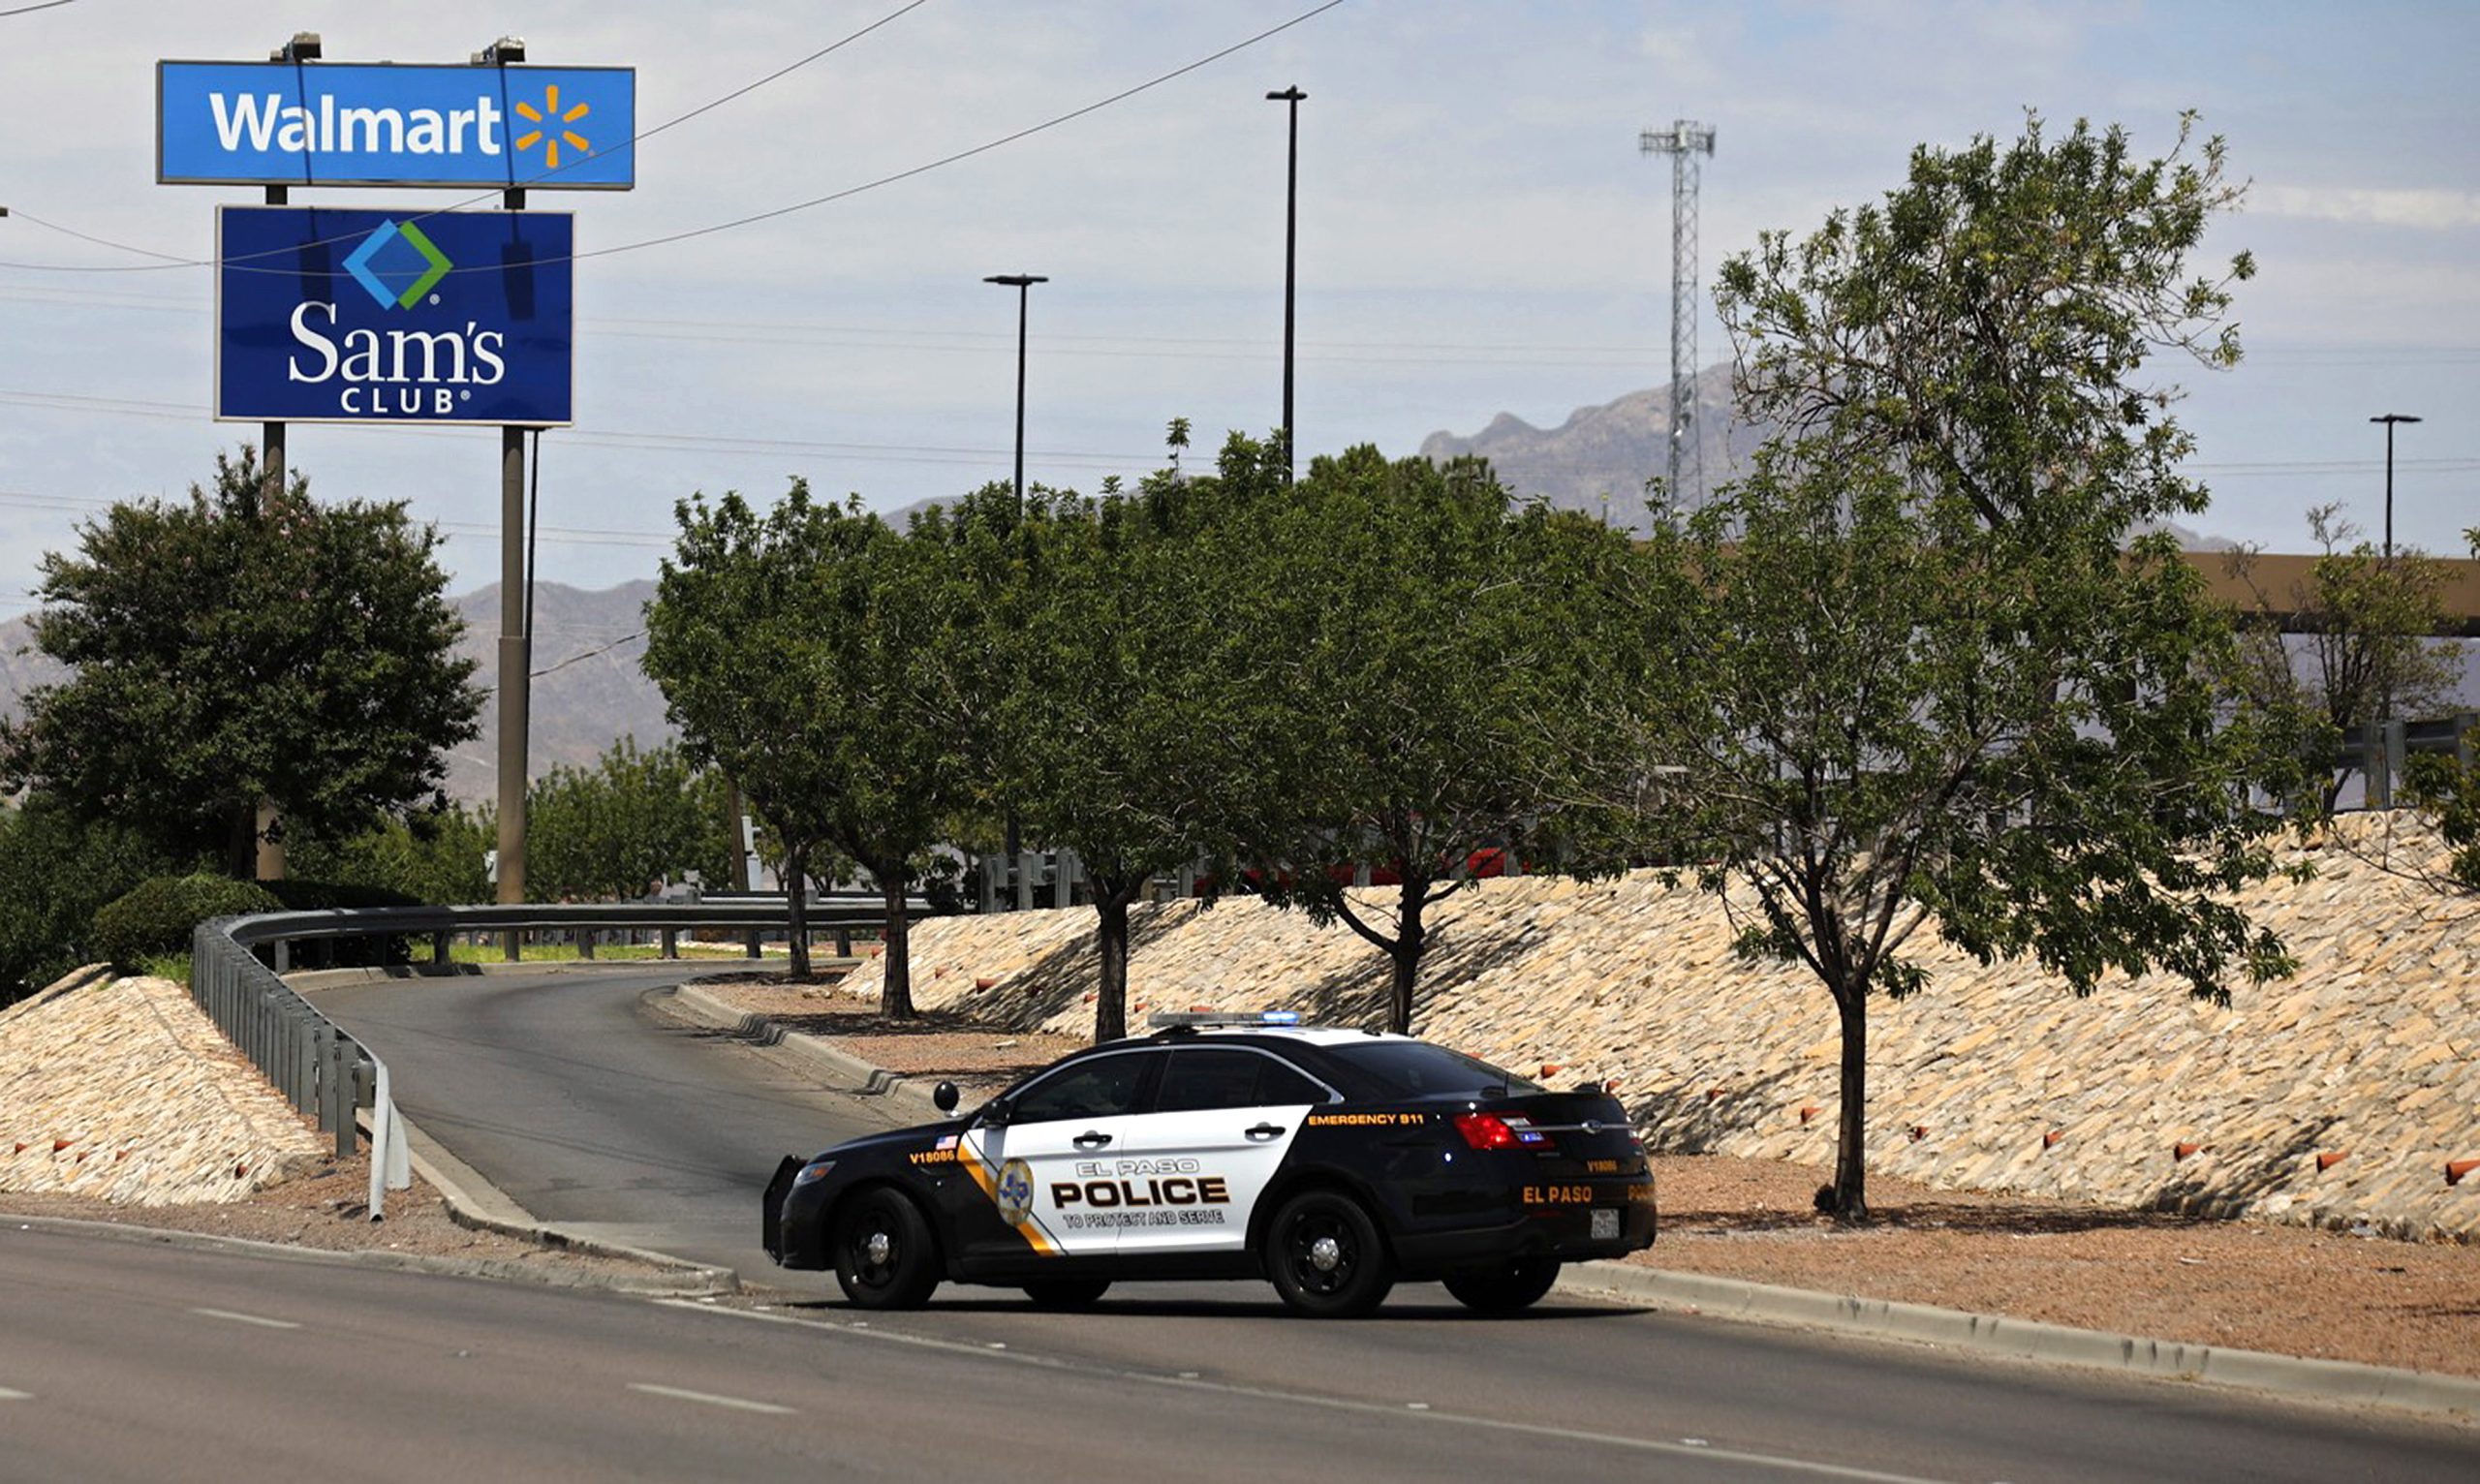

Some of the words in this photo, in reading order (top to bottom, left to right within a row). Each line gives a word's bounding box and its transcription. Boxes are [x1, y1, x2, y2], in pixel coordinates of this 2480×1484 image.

[209, 93, 500, 154] Walmart
[289, 300, 506, 385] Sam's
[1308, 1114, 1396, 1126] EMERGENCY
[1399, 1113, 1424, 1125] 911
[910, 1150, 955, 1163] V18086
[1075, 1162, 1112, 1178] EL
[1116, 1159, 1200, 1176] PASO
[1050, 1176, 1231, 1210] POLICE
[1523, 1186, 1545, 1203] EL
[1548, 1186, 1593, 1203] PASO
[1063, 1214, 1084, 1228] TO
[1084, 1212, 1147, 1228] PROTECT
[1148, 1211, 1177, 1226] AND
[1179, 1209, 1224, 1225] SERVE
